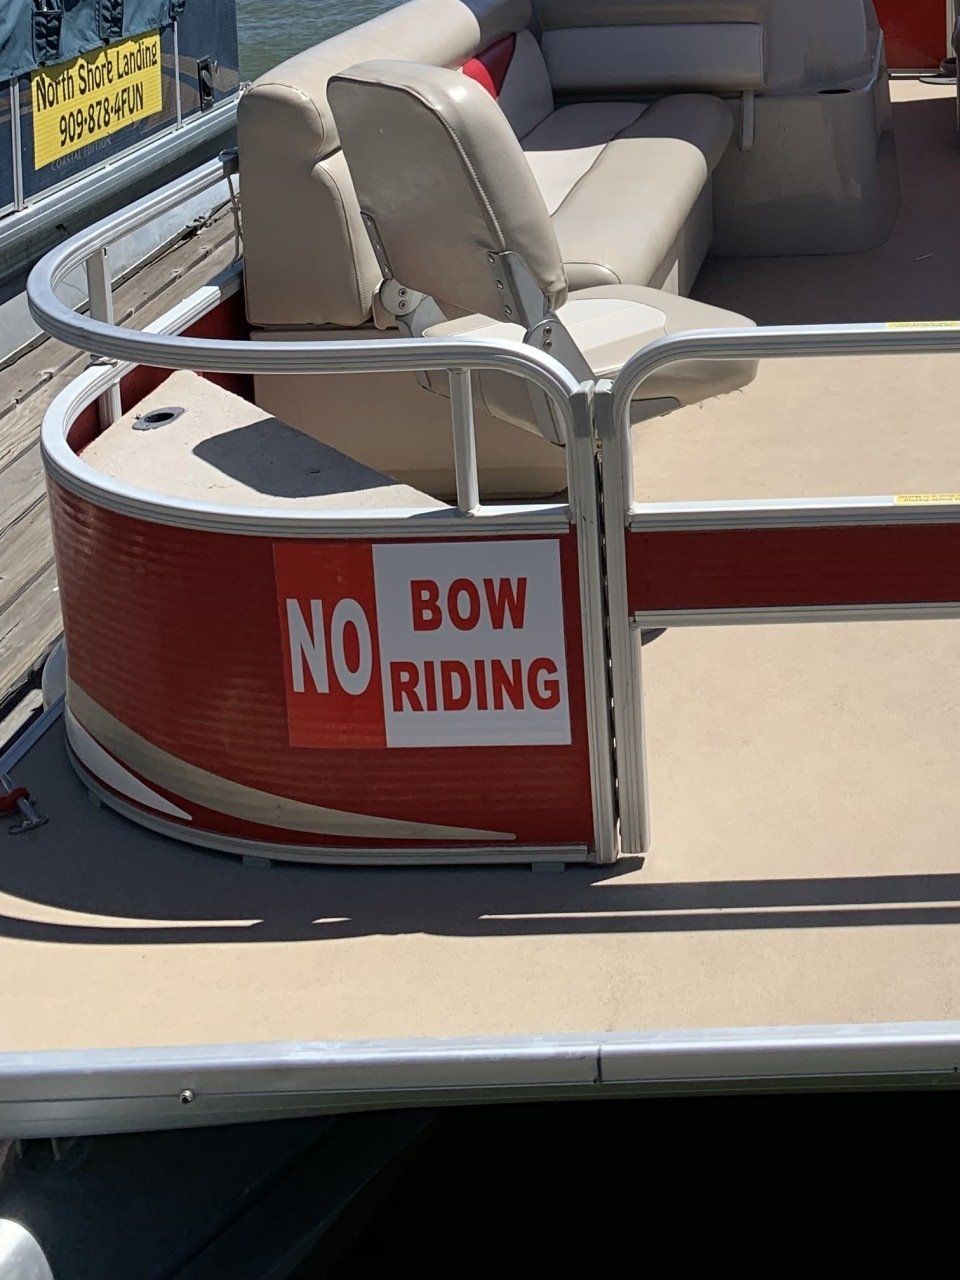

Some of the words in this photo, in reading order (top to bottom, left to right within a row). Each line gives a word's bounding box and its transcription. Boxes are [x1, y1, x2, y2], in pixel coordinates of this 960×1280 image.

[36, 68, 74, 112] North
[78, 60, 114, 95] Shore
[116, 40, 158, 80] Landing
[410, 577, 527, 632] BOW
[285, 597, 373, 696] NO
[389, 657, 561, 713] RIDING
